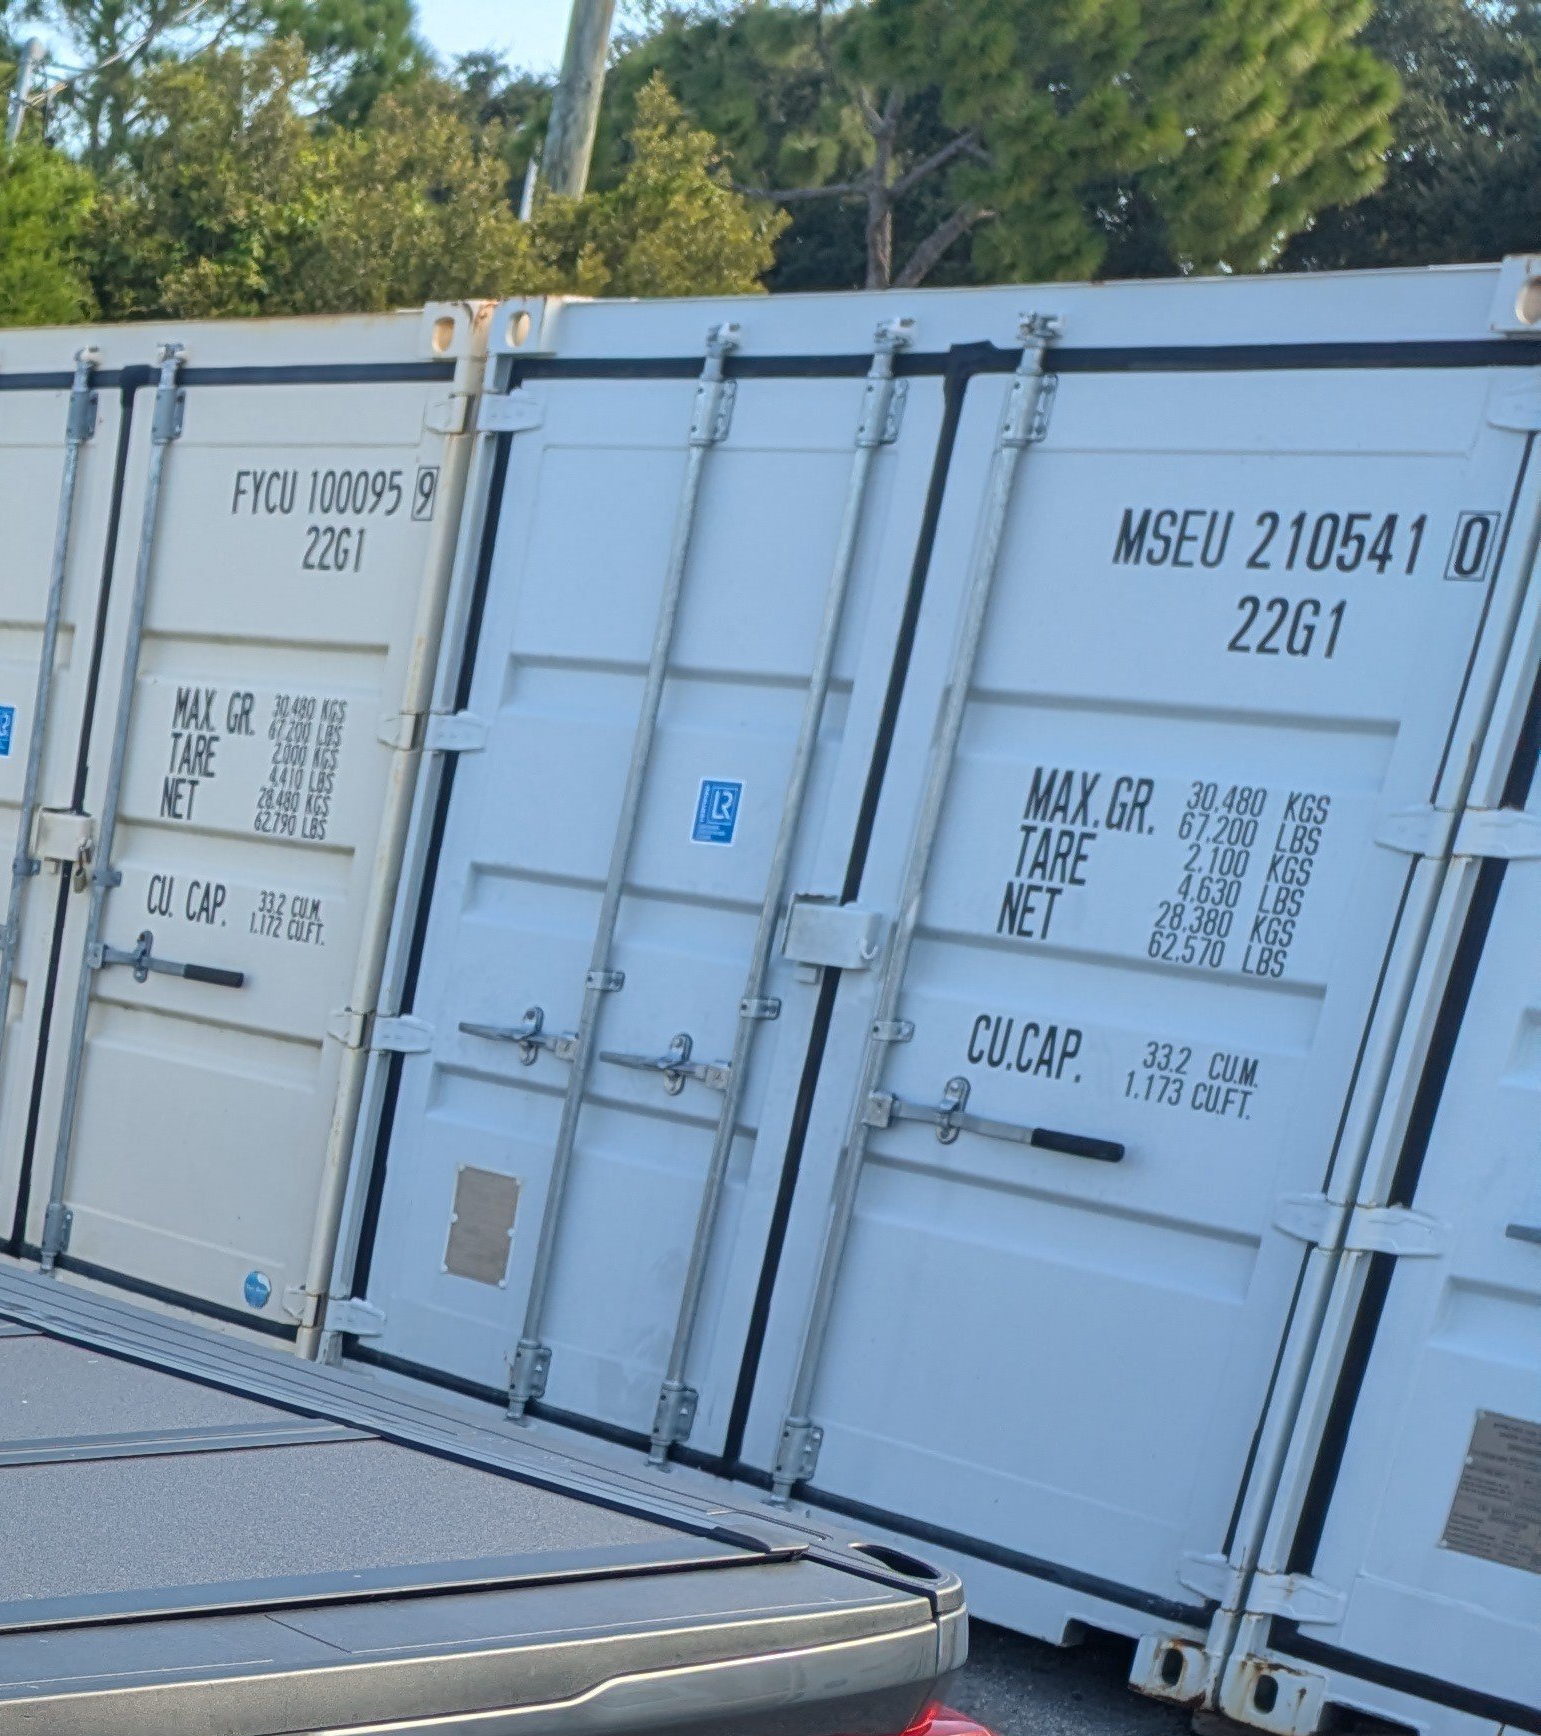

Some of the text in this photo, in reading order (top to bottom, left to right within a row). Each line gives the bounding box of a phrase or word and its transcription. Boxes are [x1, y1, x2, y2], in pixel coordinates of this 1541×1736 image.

[232, 470, 298, 515] FYCU
[308, 470, 404, 516] 100095
[302, 525, 367, 573] 22G1
[1113, 508, 1235, 568] MSEU
[1247, 511, 1428, 575] 210541
[1228, 595, 1348, 659] 22G1
[319, 699, 348, 724] KGS
[315, 723, 343, 747] LBS
[169, 732, 220, 778] TARE
[312, 747, 340, 771] KGS
[160, 776, 199, 820] NET
[304, 792, 332, 818] KGS
[308, 769, 335, 794] LBS
[1283, 791, 1332, 826] KGS
[301, 816, 328, 841] LBS
[1274, 822, 1323, 857] LBS
[1015, 824, 1098, 887] TARE
[1265, 853, 1315, 888] KGS
[185, 879, 227, 927] CAP.
[996, 881, 1064, 941] NET
[1249, 914, 1297, 949] KGS
[1257, 884, 1305, 918] LBS
[1241, 945, 1288, 979] LBS
[1142, 1041, 1193, 1076] 33.2
[1124, 1069, 1185, 1107] 1.173
